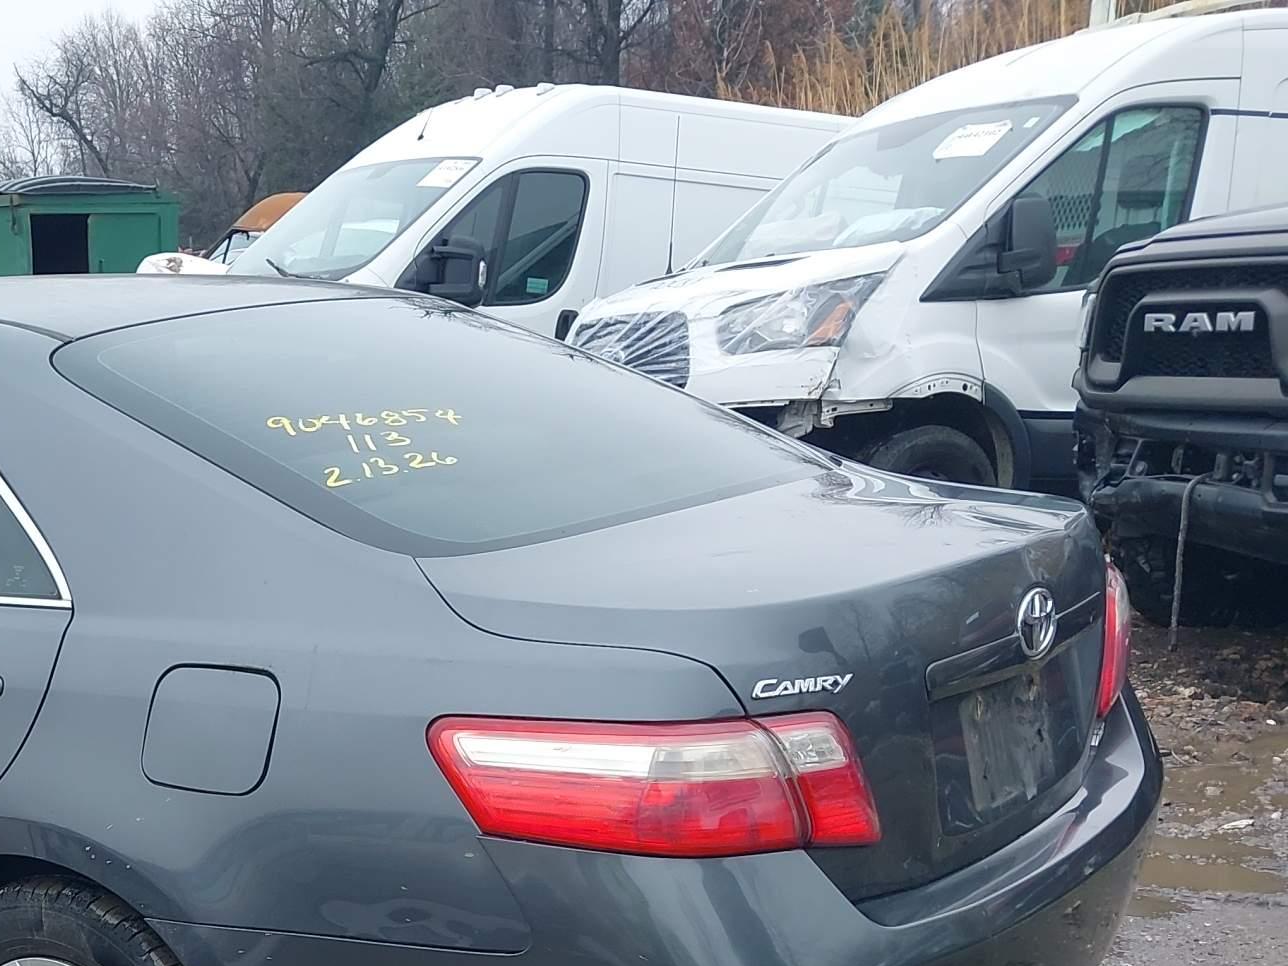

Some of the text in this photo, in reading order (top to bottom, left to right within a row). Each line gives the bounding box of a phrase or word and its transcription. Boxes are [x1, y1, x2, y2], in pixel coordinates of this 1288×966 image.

[1144, 311, 1256, 332] RAM
[346, 431, 411, 453] 113
[751, 672, 855, 700] CAMRY
